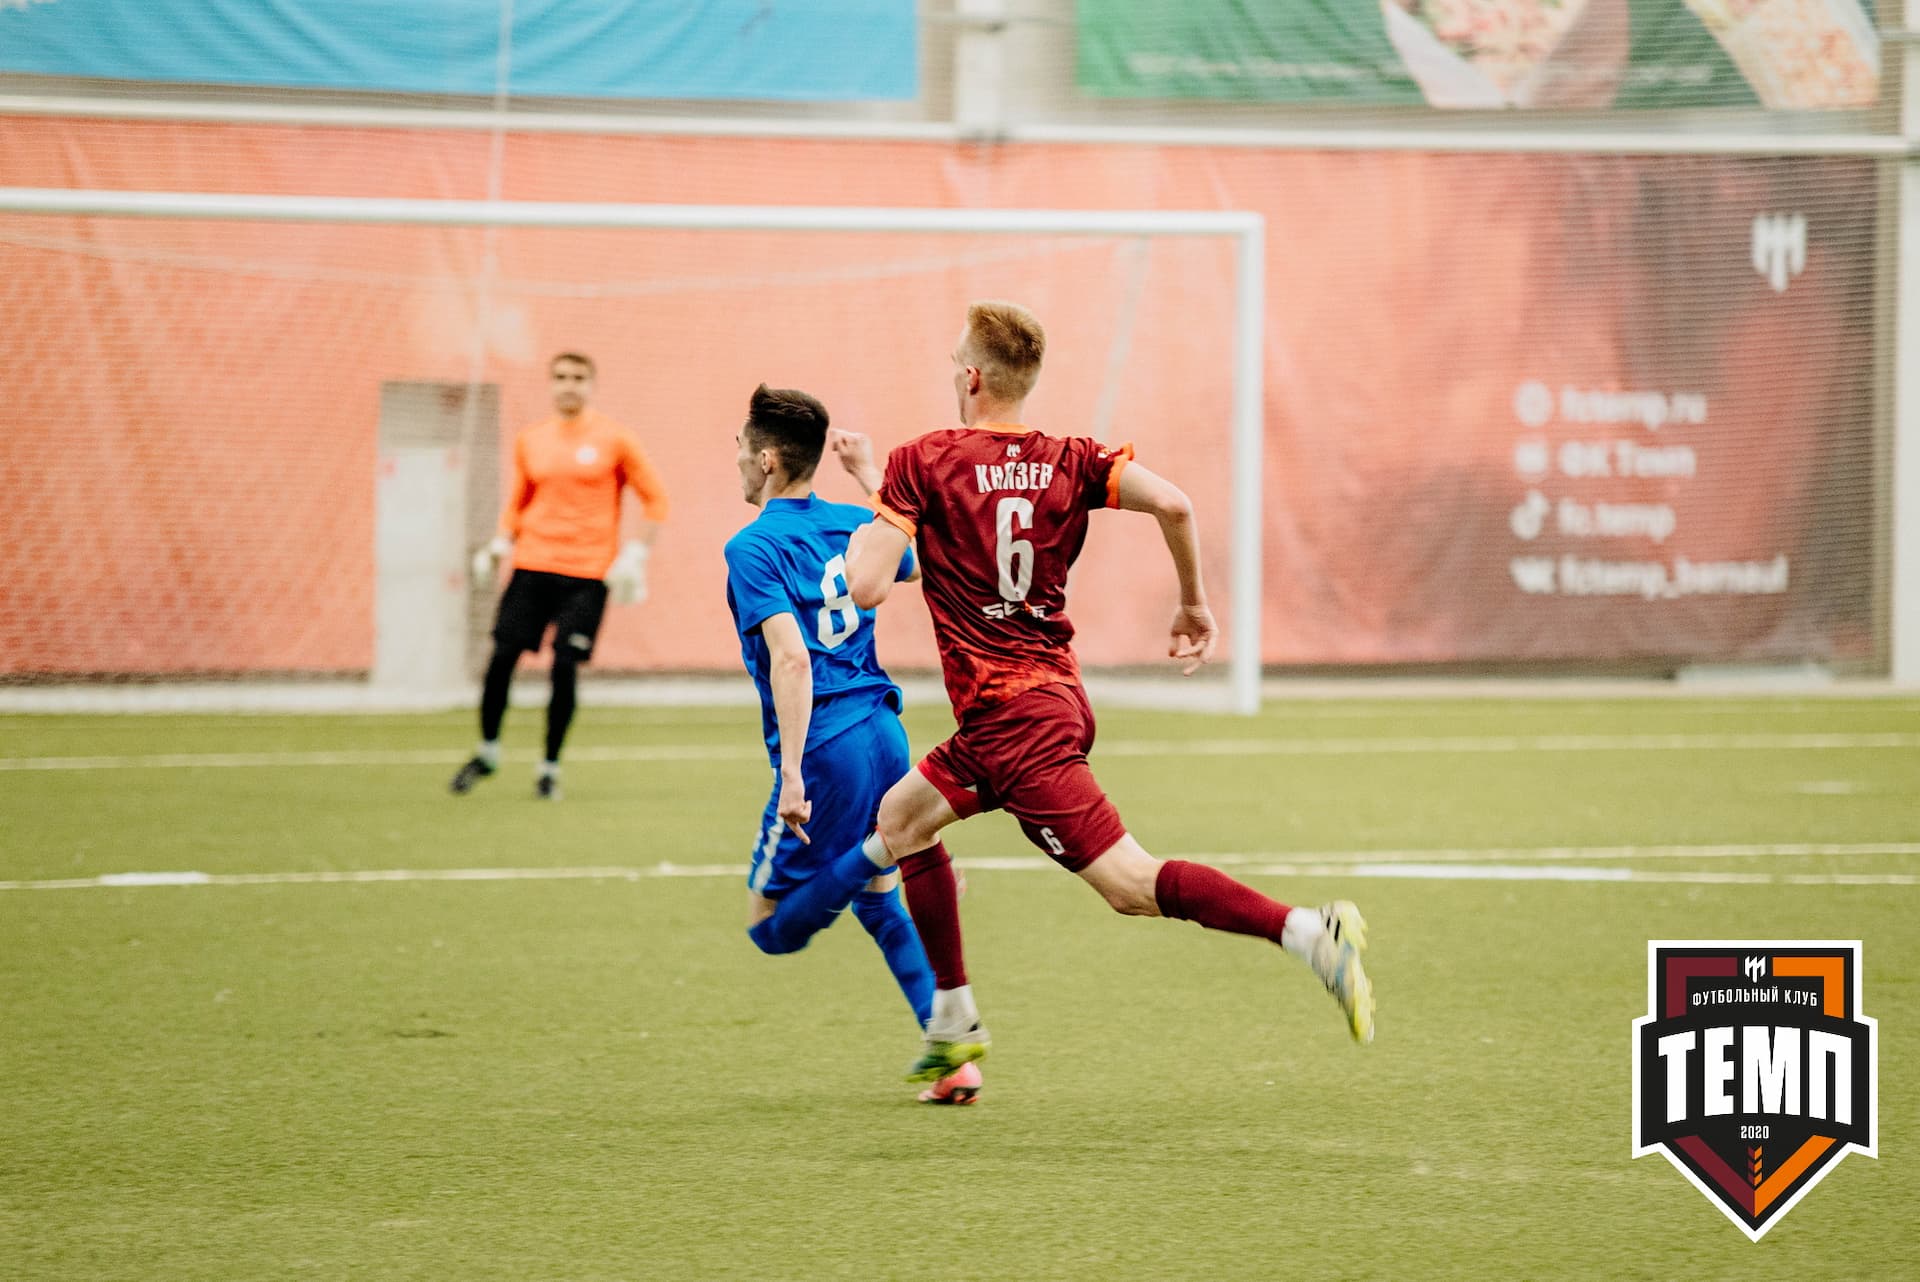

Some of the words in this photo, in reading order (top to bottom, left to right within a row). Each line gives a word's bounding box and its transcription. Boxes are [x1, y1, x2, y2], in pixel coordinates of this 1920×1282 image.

[975, 462, 1054, 493] КНЯЗЕВ
[996, 497, 1035, 602] 6
[817, 553, 859, 650] 8
[1040, 827, 1066, 855] 6
